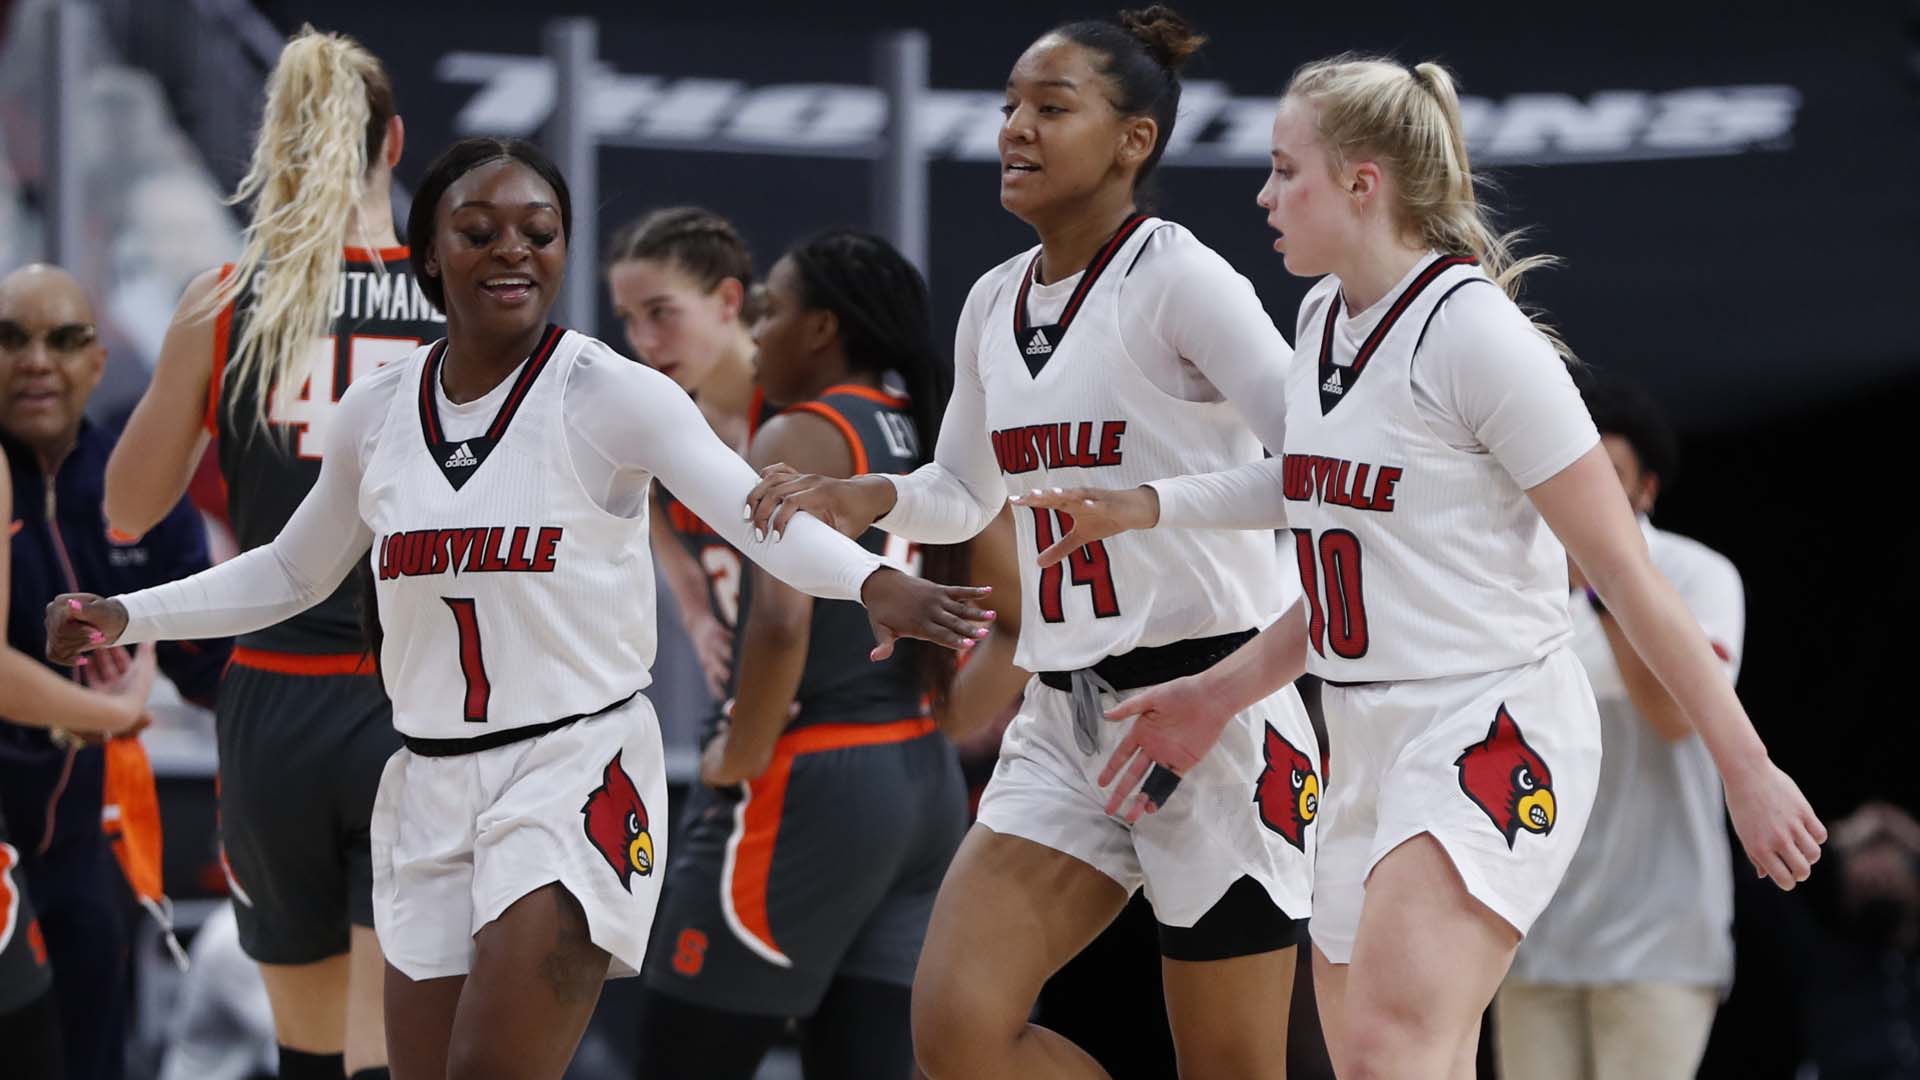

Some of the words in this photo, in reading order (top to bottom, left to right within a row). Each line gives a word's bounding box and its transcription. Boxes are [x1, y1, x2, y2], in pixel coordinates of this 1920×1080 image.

[1026, 345, 1053, 355] adidas
[1322, 383, 1344, 395] adidas
[445, 457, 478, 468] adidas
[989, 421, 1127, 475] OUISVILLE
[1282, 453, 1404, 512] UISVILLE
[379, 527, 564, 581] LOUISVILLE
[1030, 503, 1121, 624] 14
[1290, 527, 1370, 661] 10
[440, 596, 491, 723] 1
